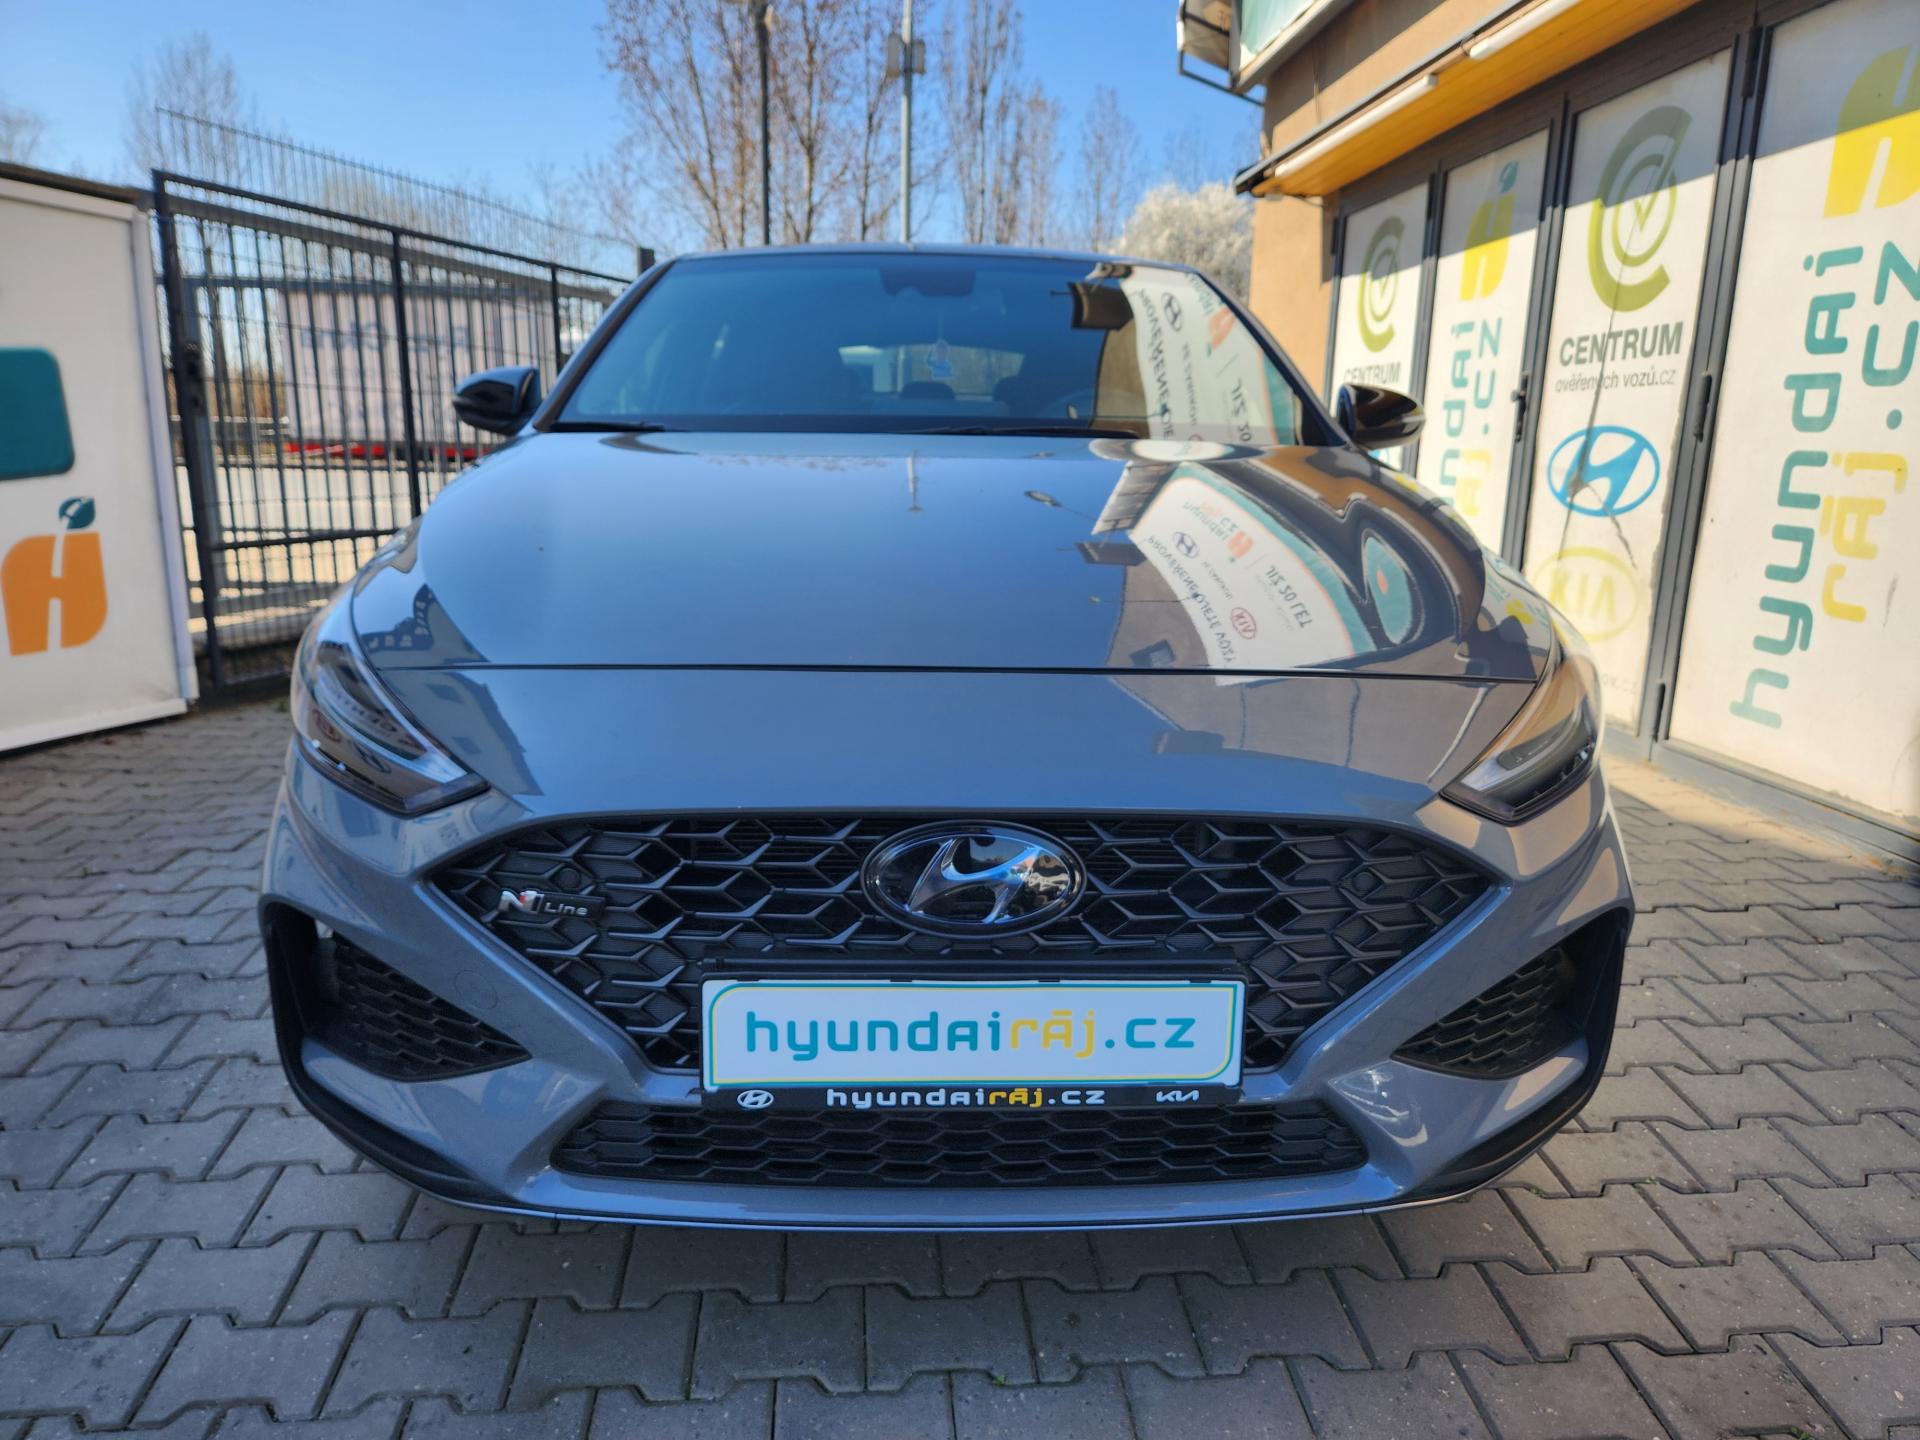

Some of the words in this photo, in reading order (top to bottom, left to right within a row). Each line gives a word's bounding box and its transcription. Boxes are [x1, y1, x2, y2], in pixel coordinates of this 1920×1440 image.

[1560, 321, 1684, 367] CENTRUM
[1343, 361, 1402, 385] CENTRUM
[1440, 321, 1476, 506] ndai
[1729, 245, 1864, 729] hyundai
[1551, 569, 1617, 624] KIA
[544, 901, 588, 917] Line
